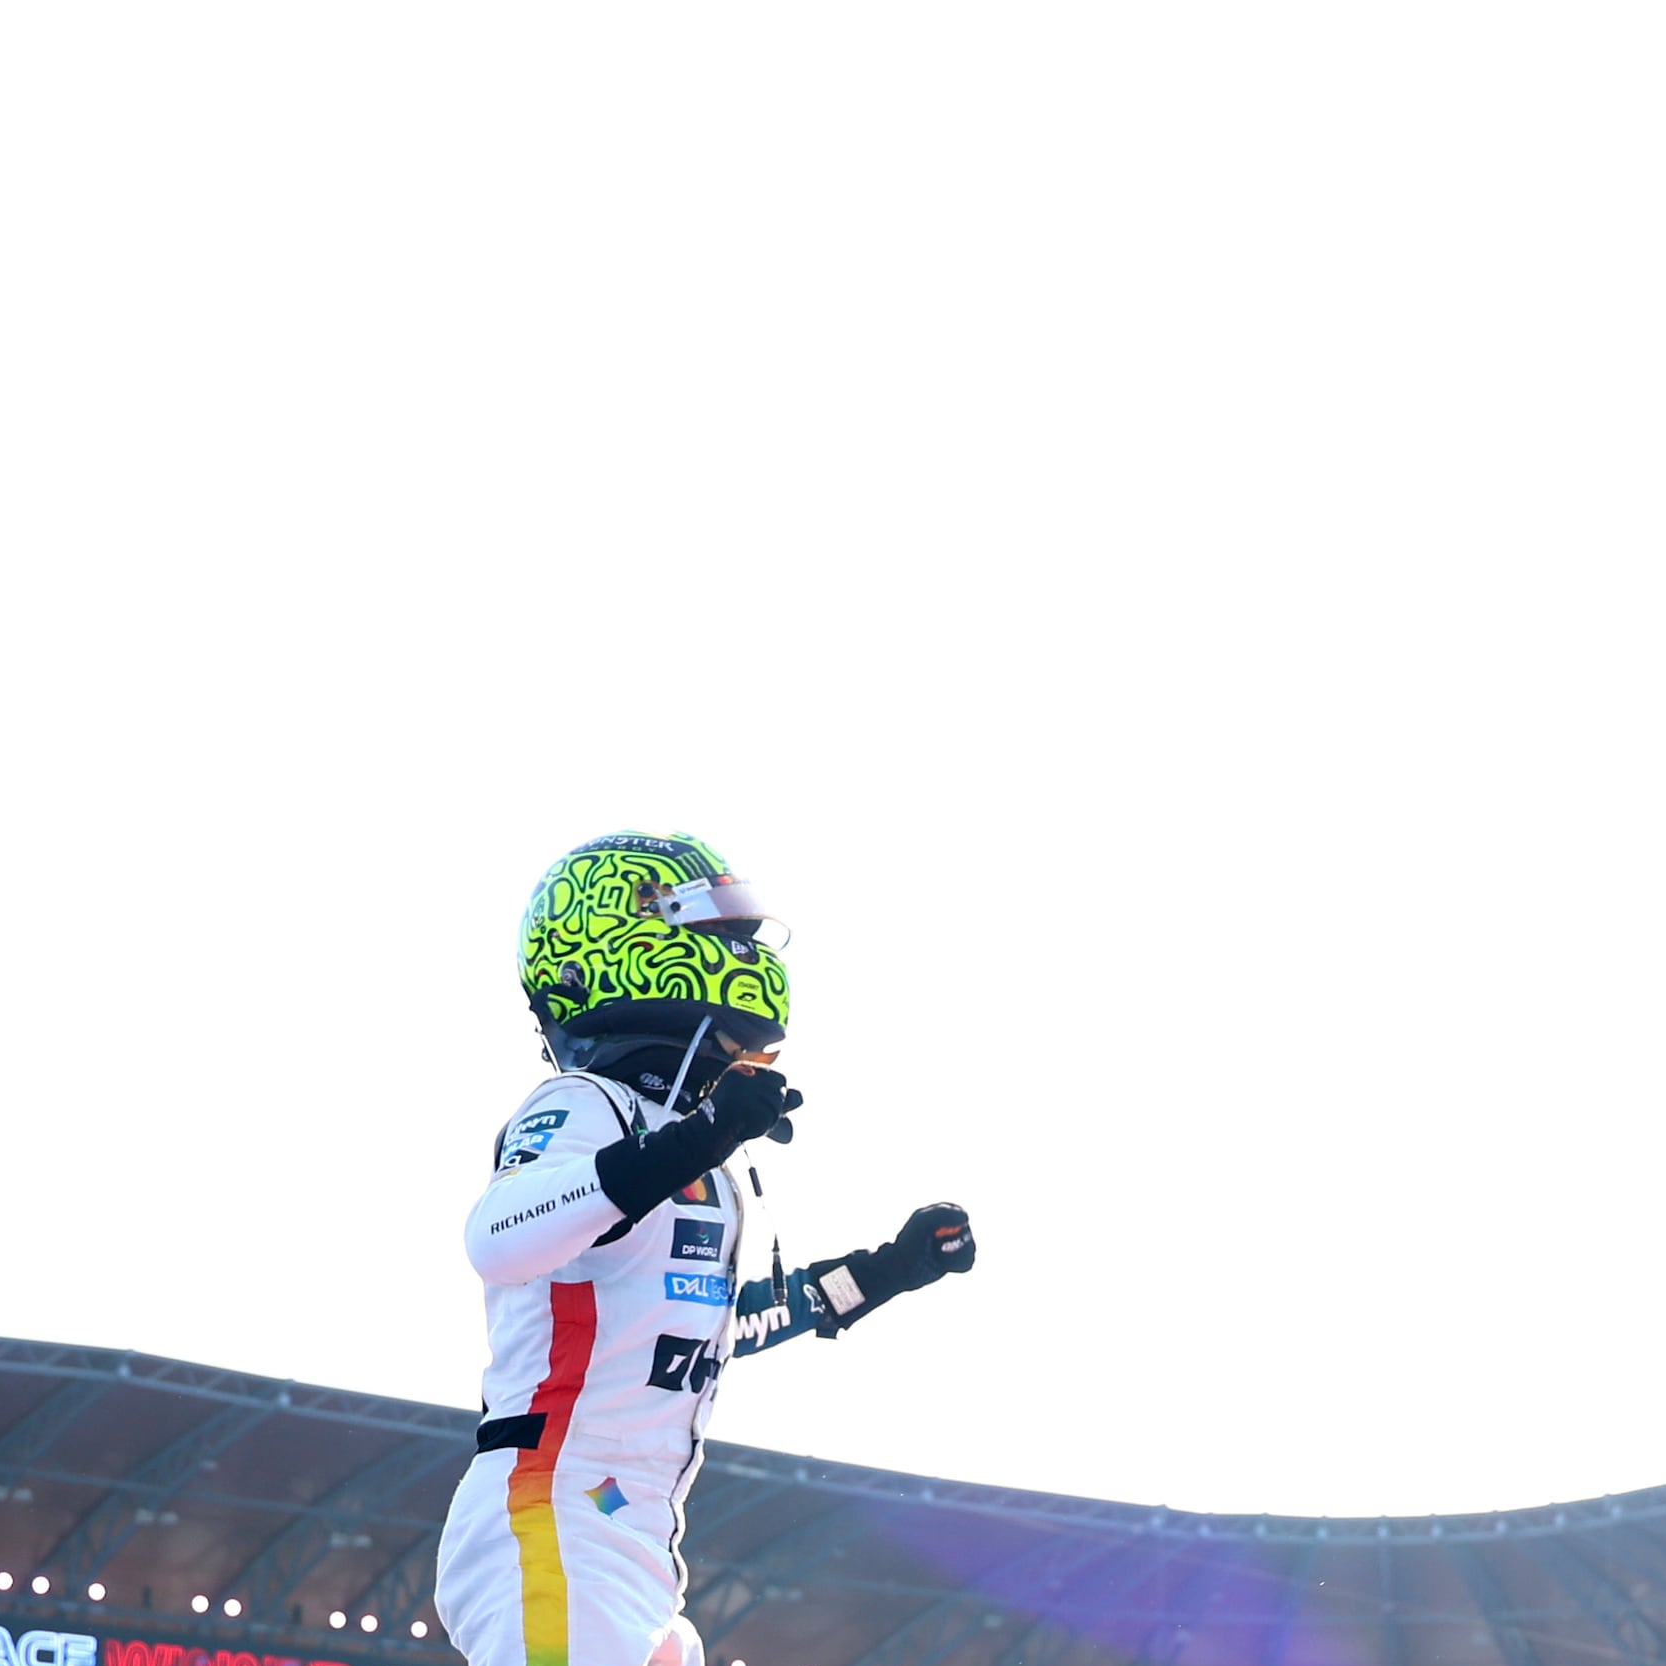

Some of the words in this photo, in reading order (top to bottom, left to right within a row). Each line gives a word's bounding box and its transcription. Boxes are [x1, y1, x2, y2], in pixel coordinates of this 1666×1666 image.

[490, 1199, 556, 1236] RICHARD
[561, 1181, 601, 1206] MILL
[672, 1277, 709, 1297] DELL
[735, 1305, 790, 1347] wyn
